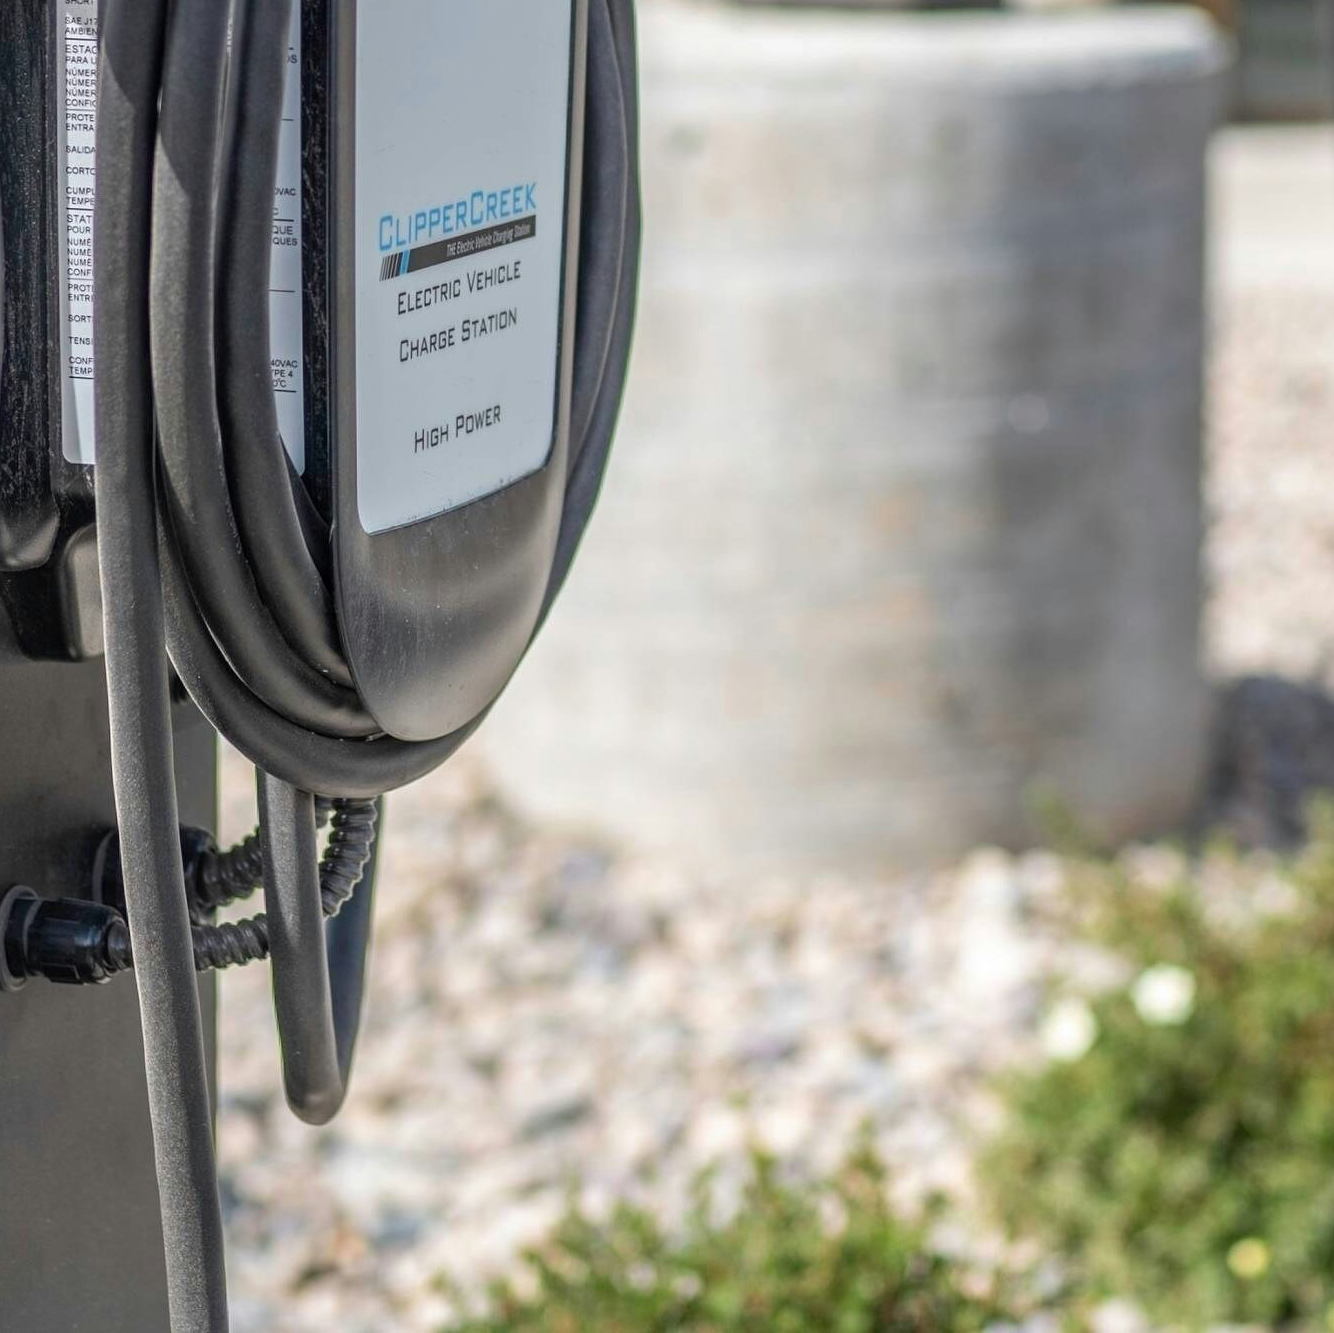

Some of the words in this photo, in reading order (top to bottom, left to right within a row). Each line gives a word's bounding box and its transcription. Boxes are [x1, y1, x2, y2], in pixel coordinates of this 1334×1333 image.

[65, 16, 82, 25] SAE
[65, 56, 88, 64] PARA
[67, 225, 91, 234] POUR
